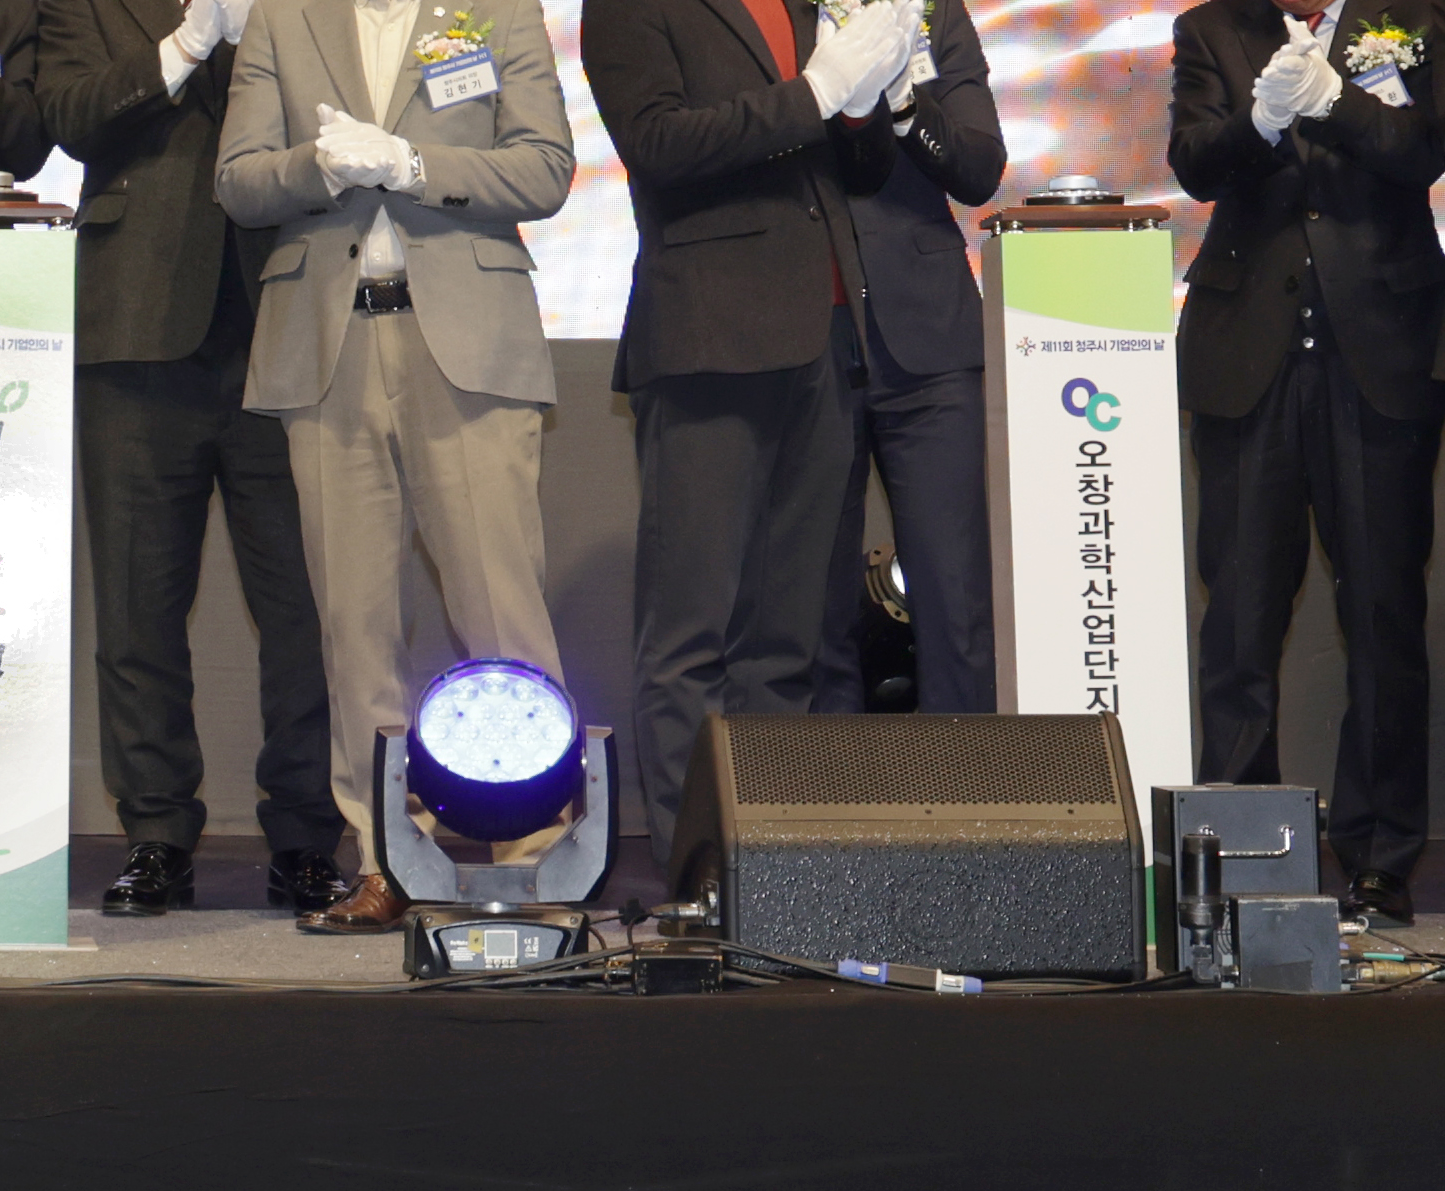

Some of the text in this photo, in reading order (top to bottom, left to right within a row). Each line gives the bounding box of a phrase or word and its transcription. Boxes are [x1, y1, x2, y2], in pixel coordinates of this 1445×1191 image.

[443, 79, 482, 99] 김현기
[7, 338, 49, 351] 기업인의
[51, 339, 63, 352] 날
[1041, 338, 1165, 353] 제11회 청주시 기업인의 날
[1075, 440, 1120, 716] 오창과학산업단지
